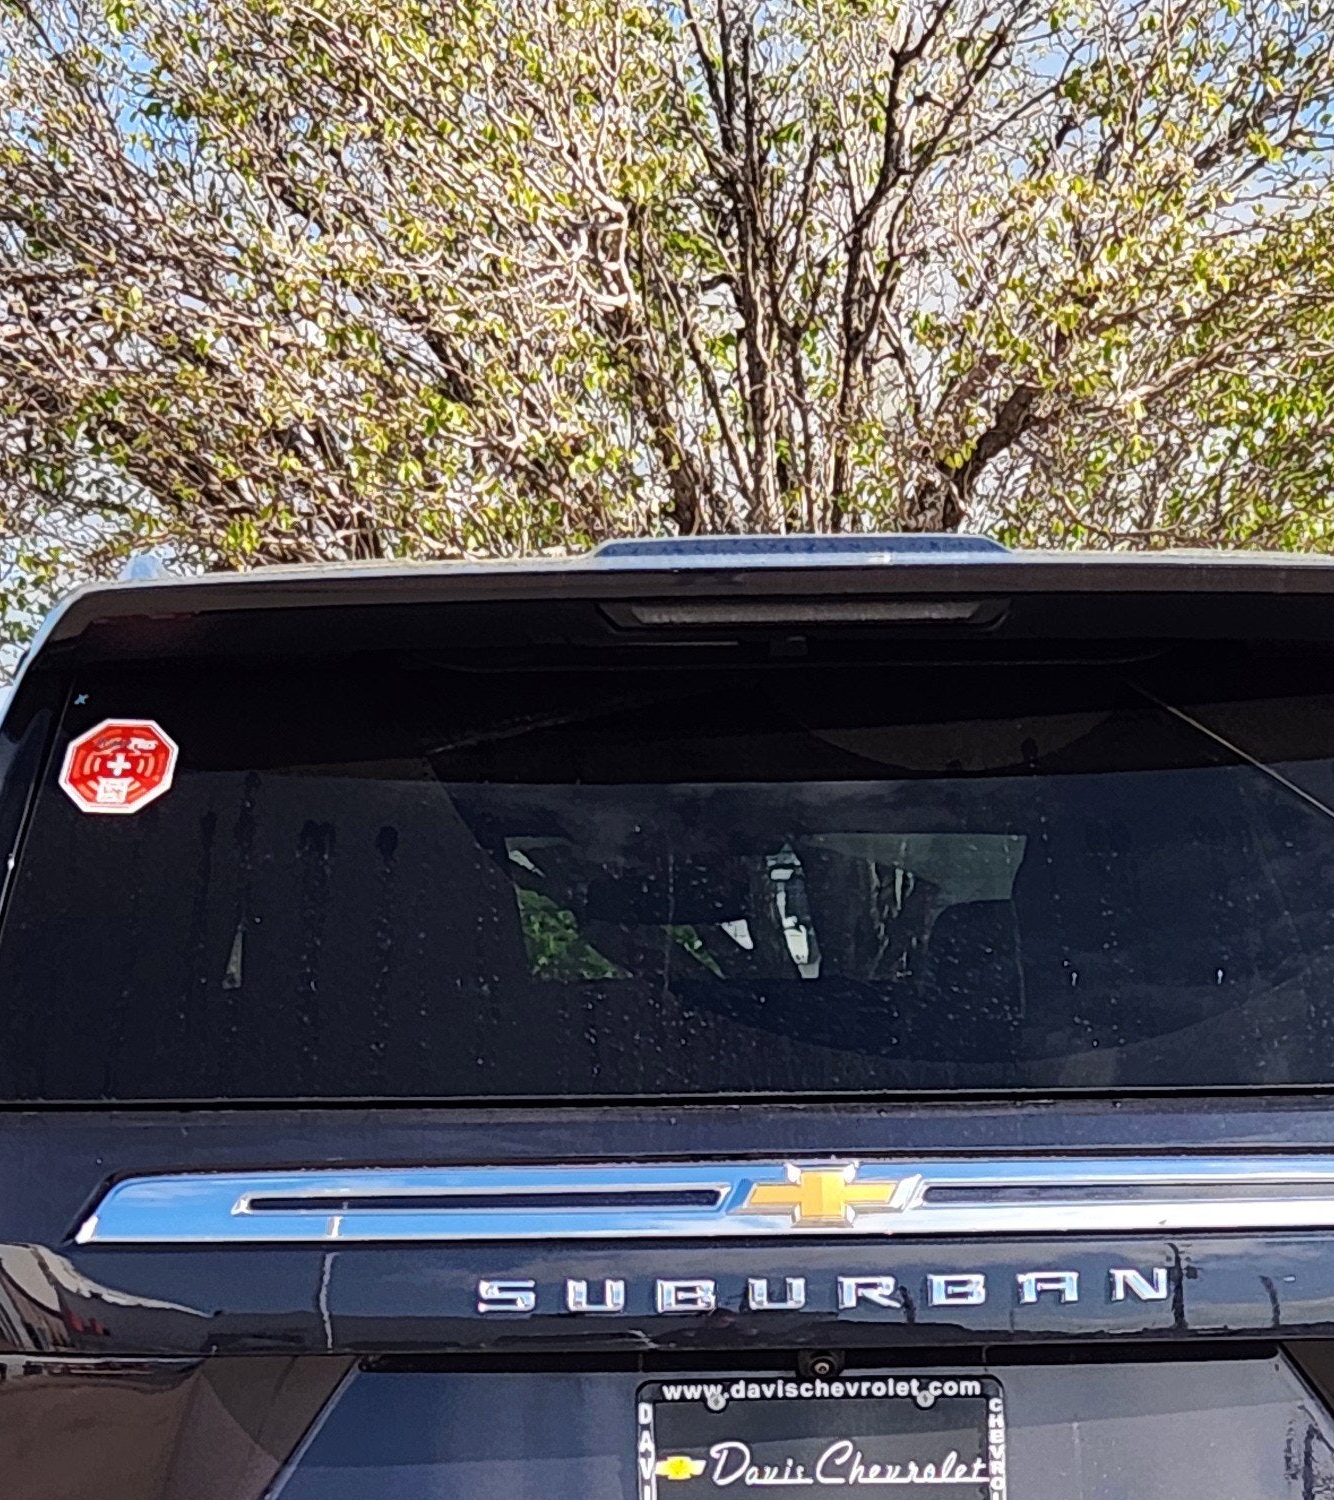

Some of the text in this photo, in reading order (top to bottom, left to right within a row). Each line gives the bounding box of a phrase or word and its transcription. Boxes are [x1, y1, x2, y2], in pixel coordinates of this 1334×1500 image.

[477, 1268, 1170, 1312] SUBURBAN
[662, 1378, 981, 1401] www.davischevroletcom
[710, 1440, 989, 1486] Davis Chevrolet
